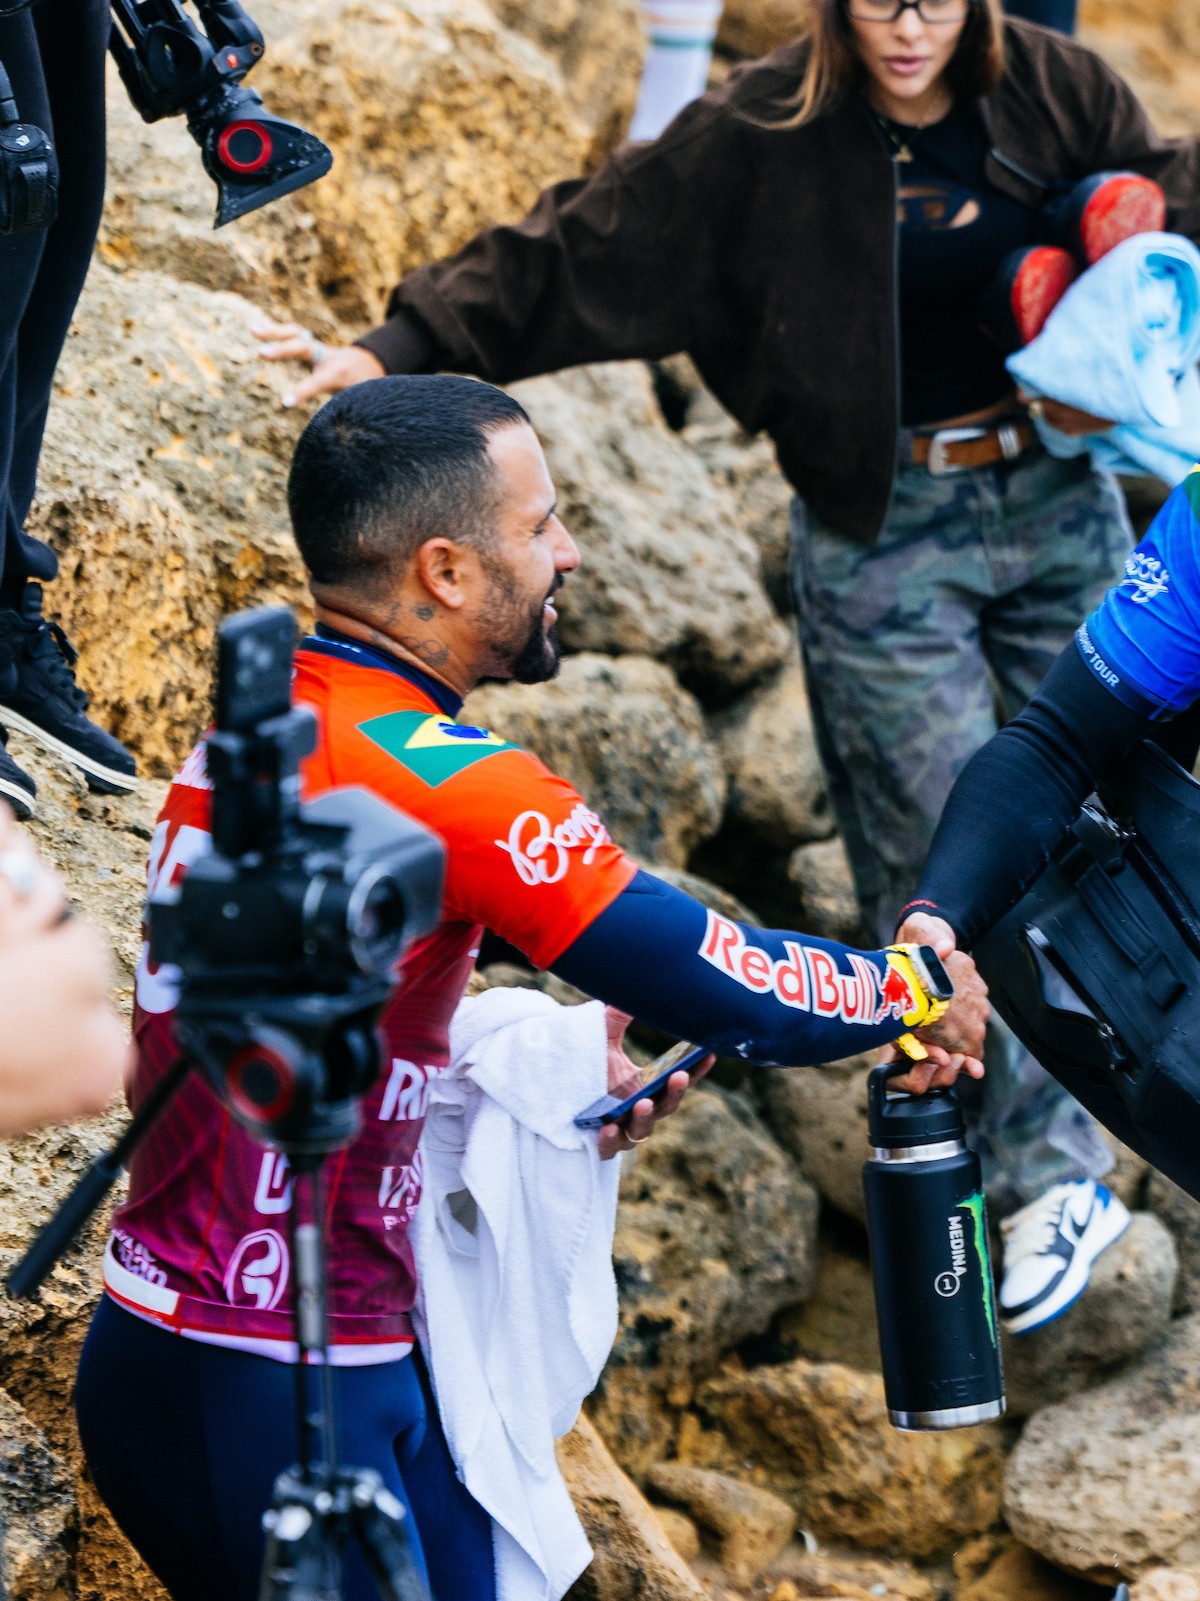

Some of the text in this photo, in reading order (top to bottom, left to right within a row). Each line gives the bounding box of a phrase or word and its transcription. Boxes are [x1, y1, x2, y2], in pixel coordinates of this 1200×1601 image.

[1089, 653, 1120, 688] TOUR
[701, 911, 877, 1024] Red Bull
[947, 1215, 967, 1277] MEDINA
